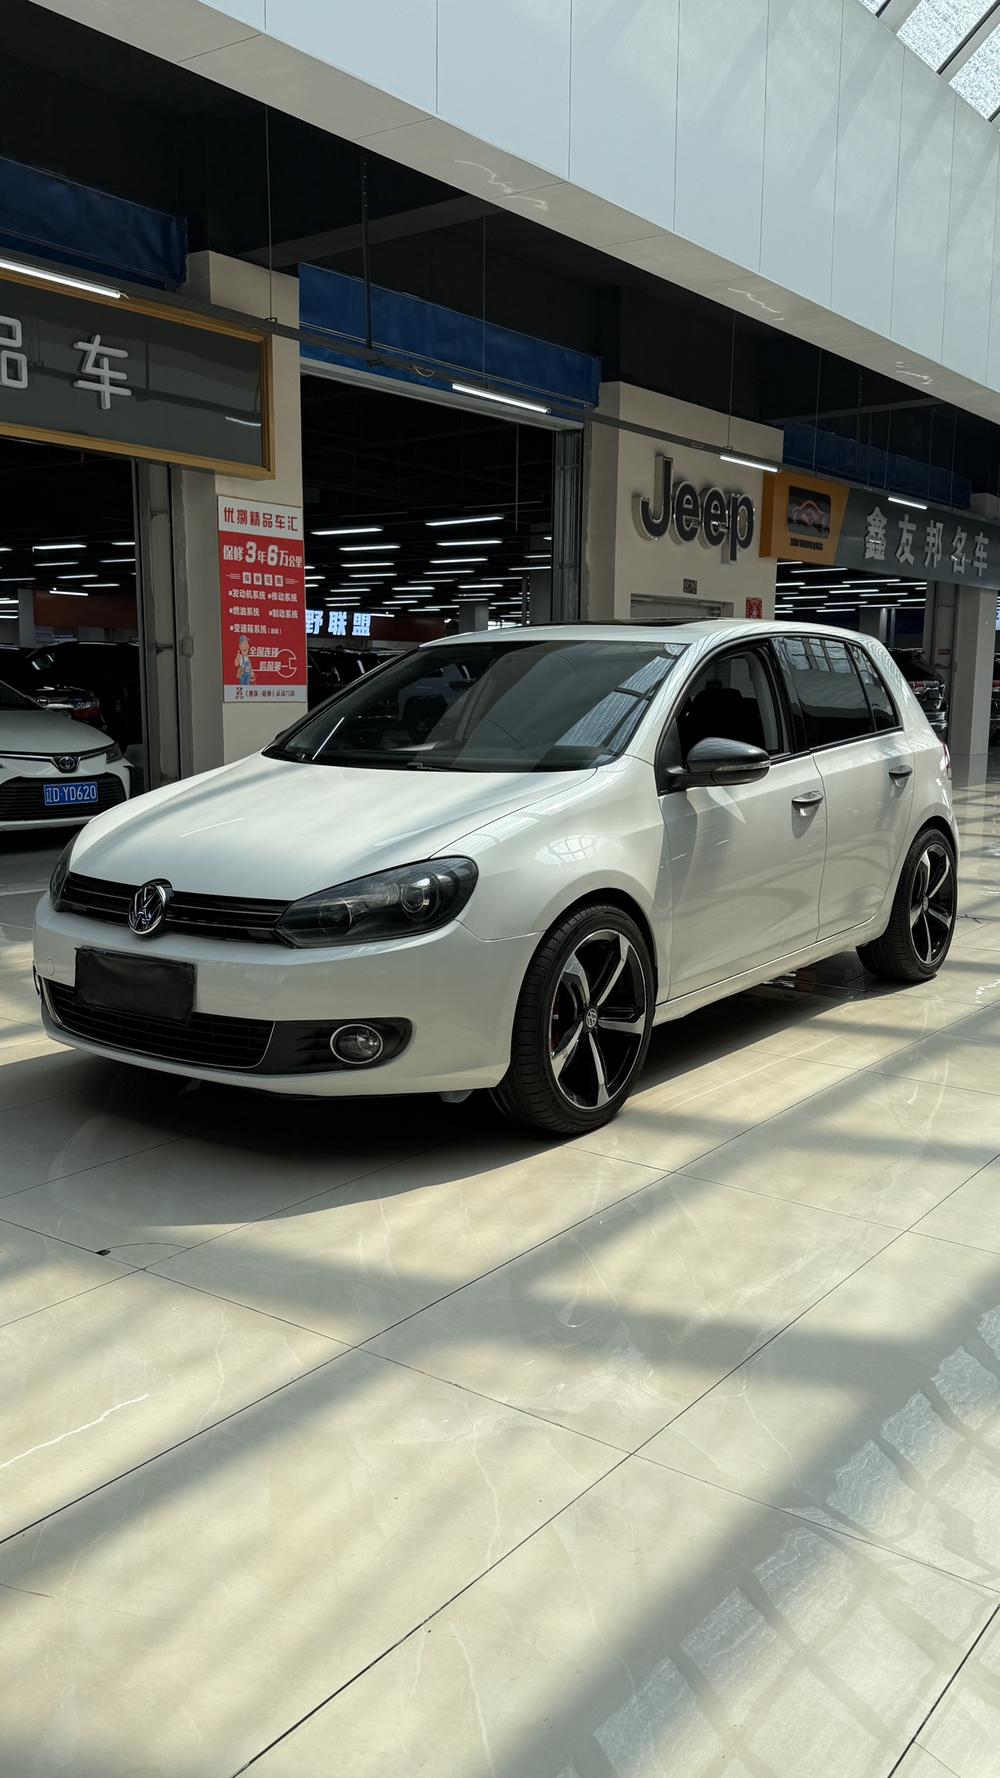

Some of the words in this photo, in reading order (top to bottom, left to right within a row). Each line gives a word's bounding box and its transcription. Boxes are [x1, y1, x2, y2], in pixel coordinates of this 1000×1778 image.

[632, 453, 756, 564] Jeep
[223, 541, 303, 568] 保修3年6万公里
[864, 506, 990, 577] 鑫友邦名车
[305, 609, 371, 637] 野联盟
